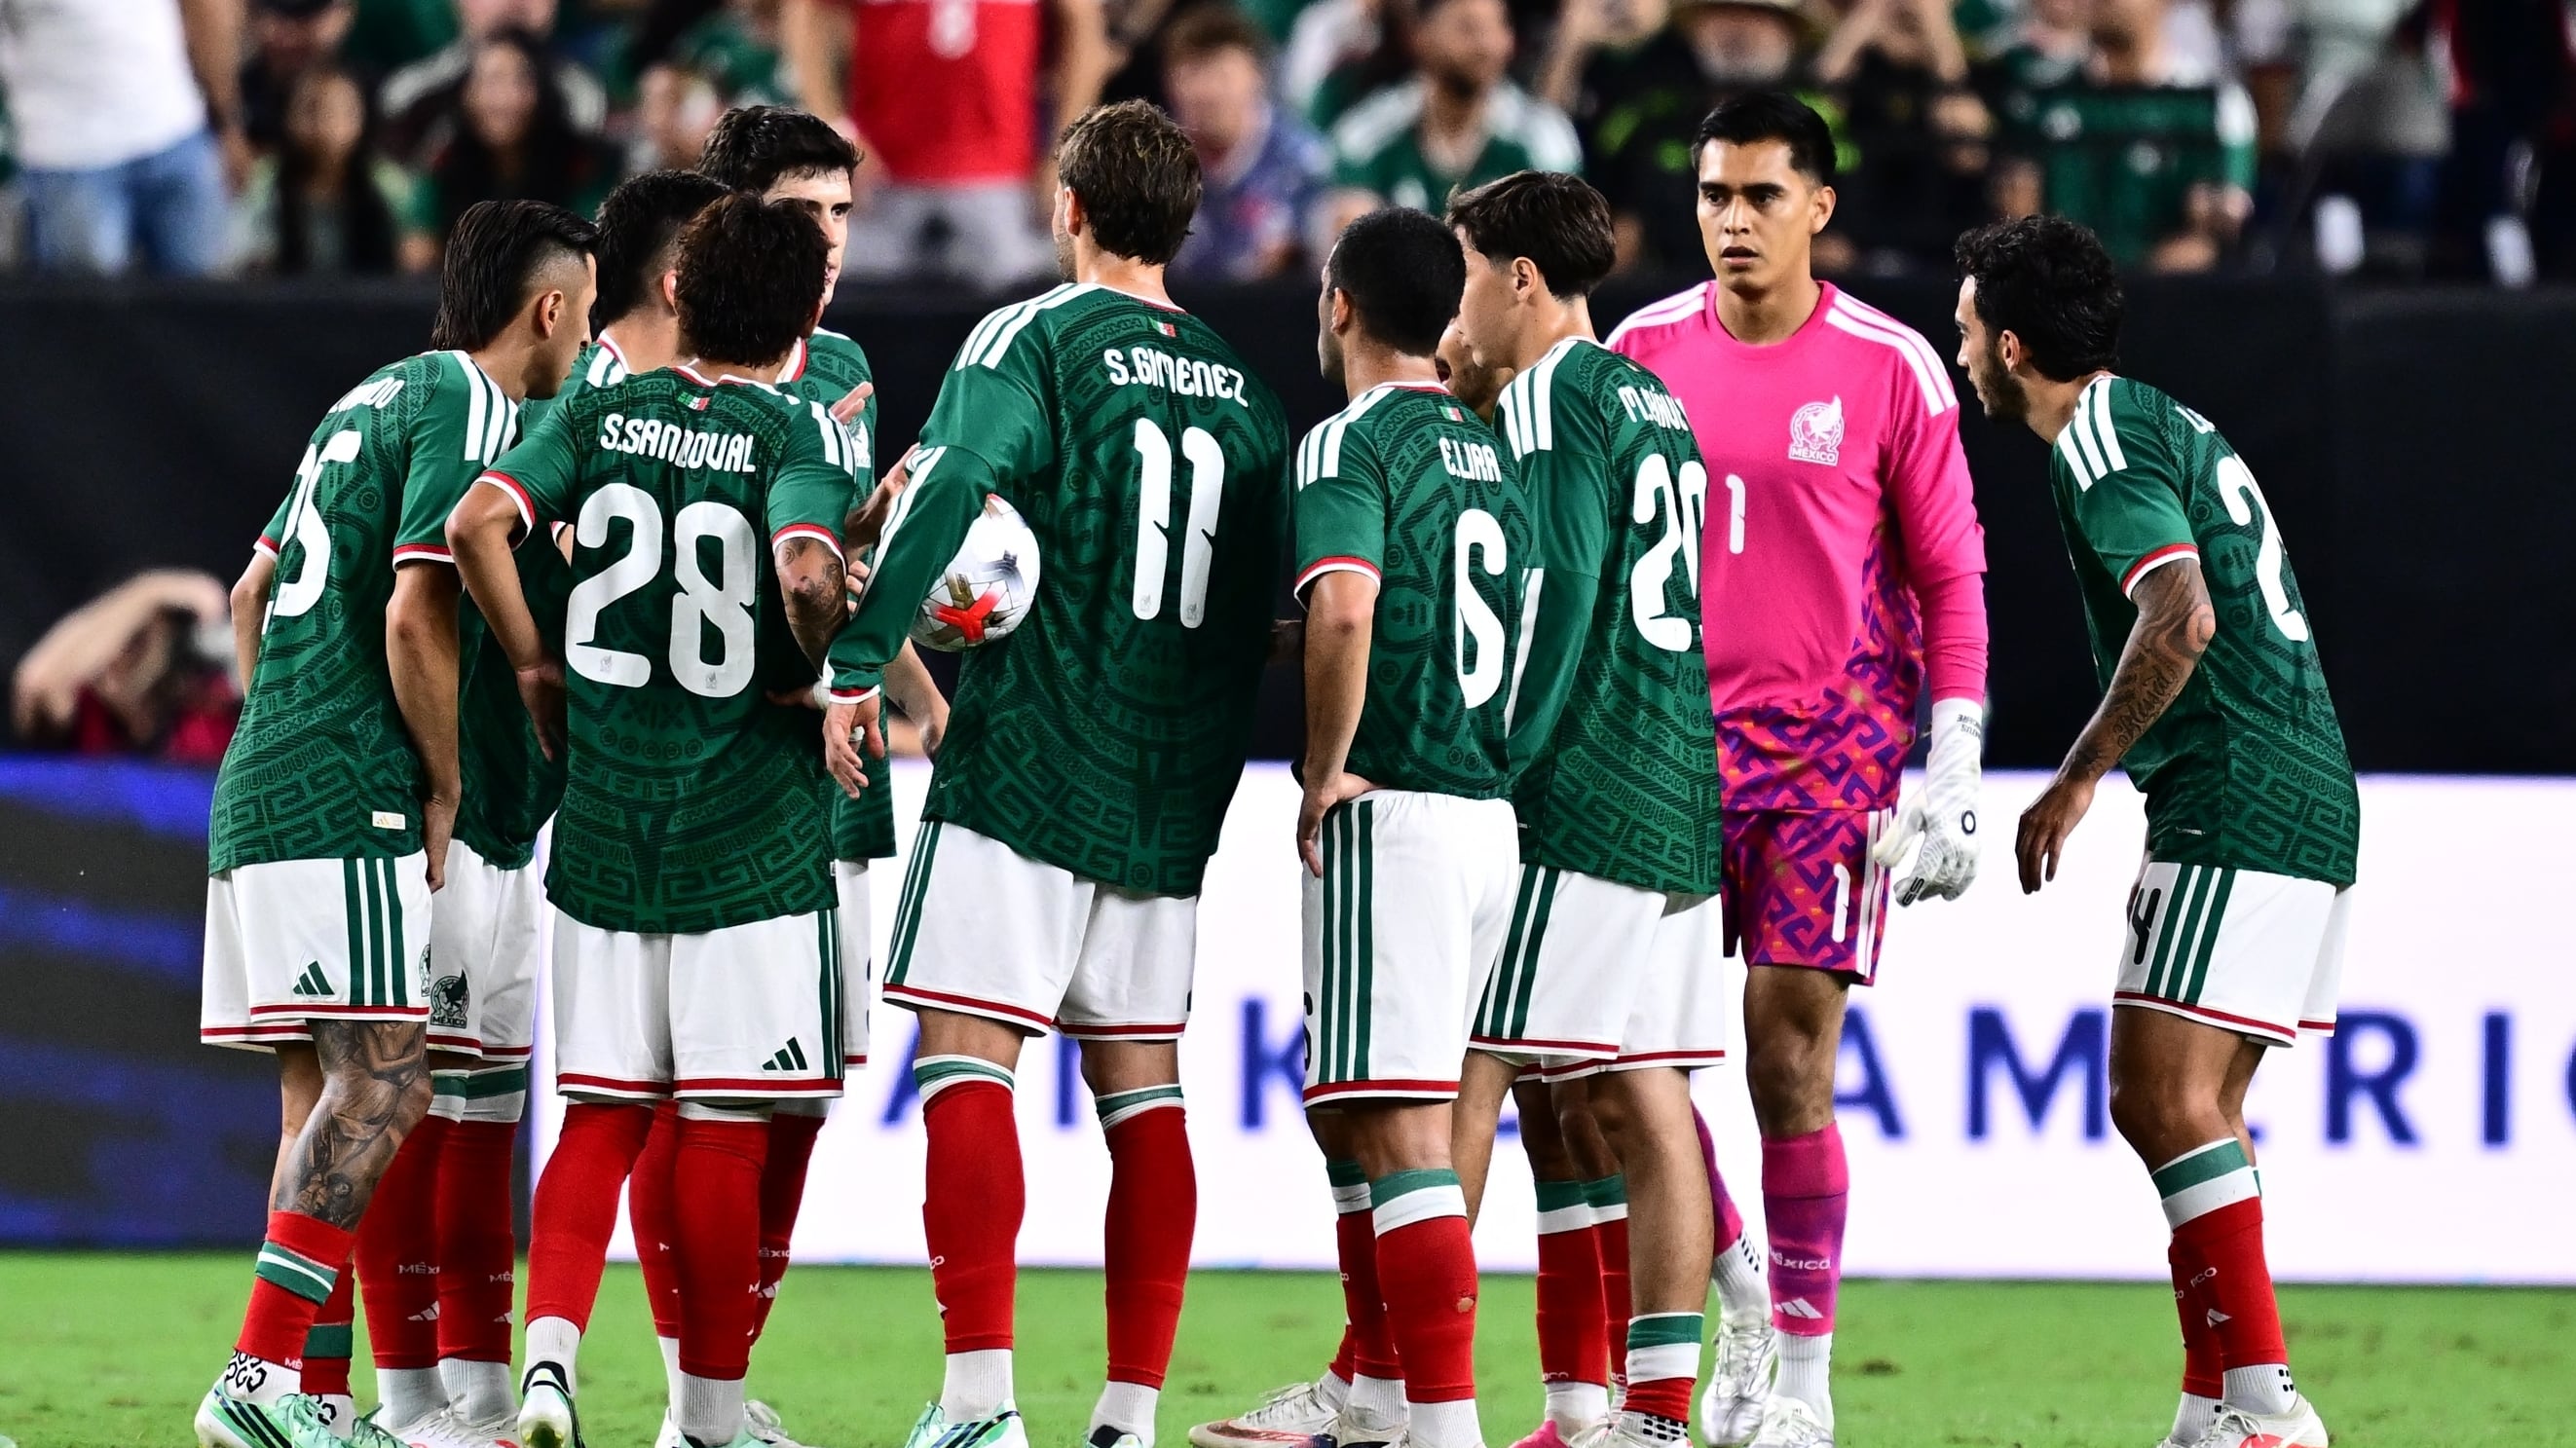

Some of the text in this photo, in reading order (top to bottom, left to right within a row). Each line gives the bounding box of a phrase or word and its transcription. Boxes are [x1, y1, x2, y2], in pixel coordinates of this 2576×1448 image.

[1103, 347, 1249, 408] S.GIMENEZ
[600, 413, 757, 473] S.SANDOVAL
[1133, 418, 1225, 629] 11
[1726, 474, 1745, 554] 1
[565, 482, 757, 698] 28
[1455, 508, 1508, 710] 6
[1832, 863, 1850, 944] 1
